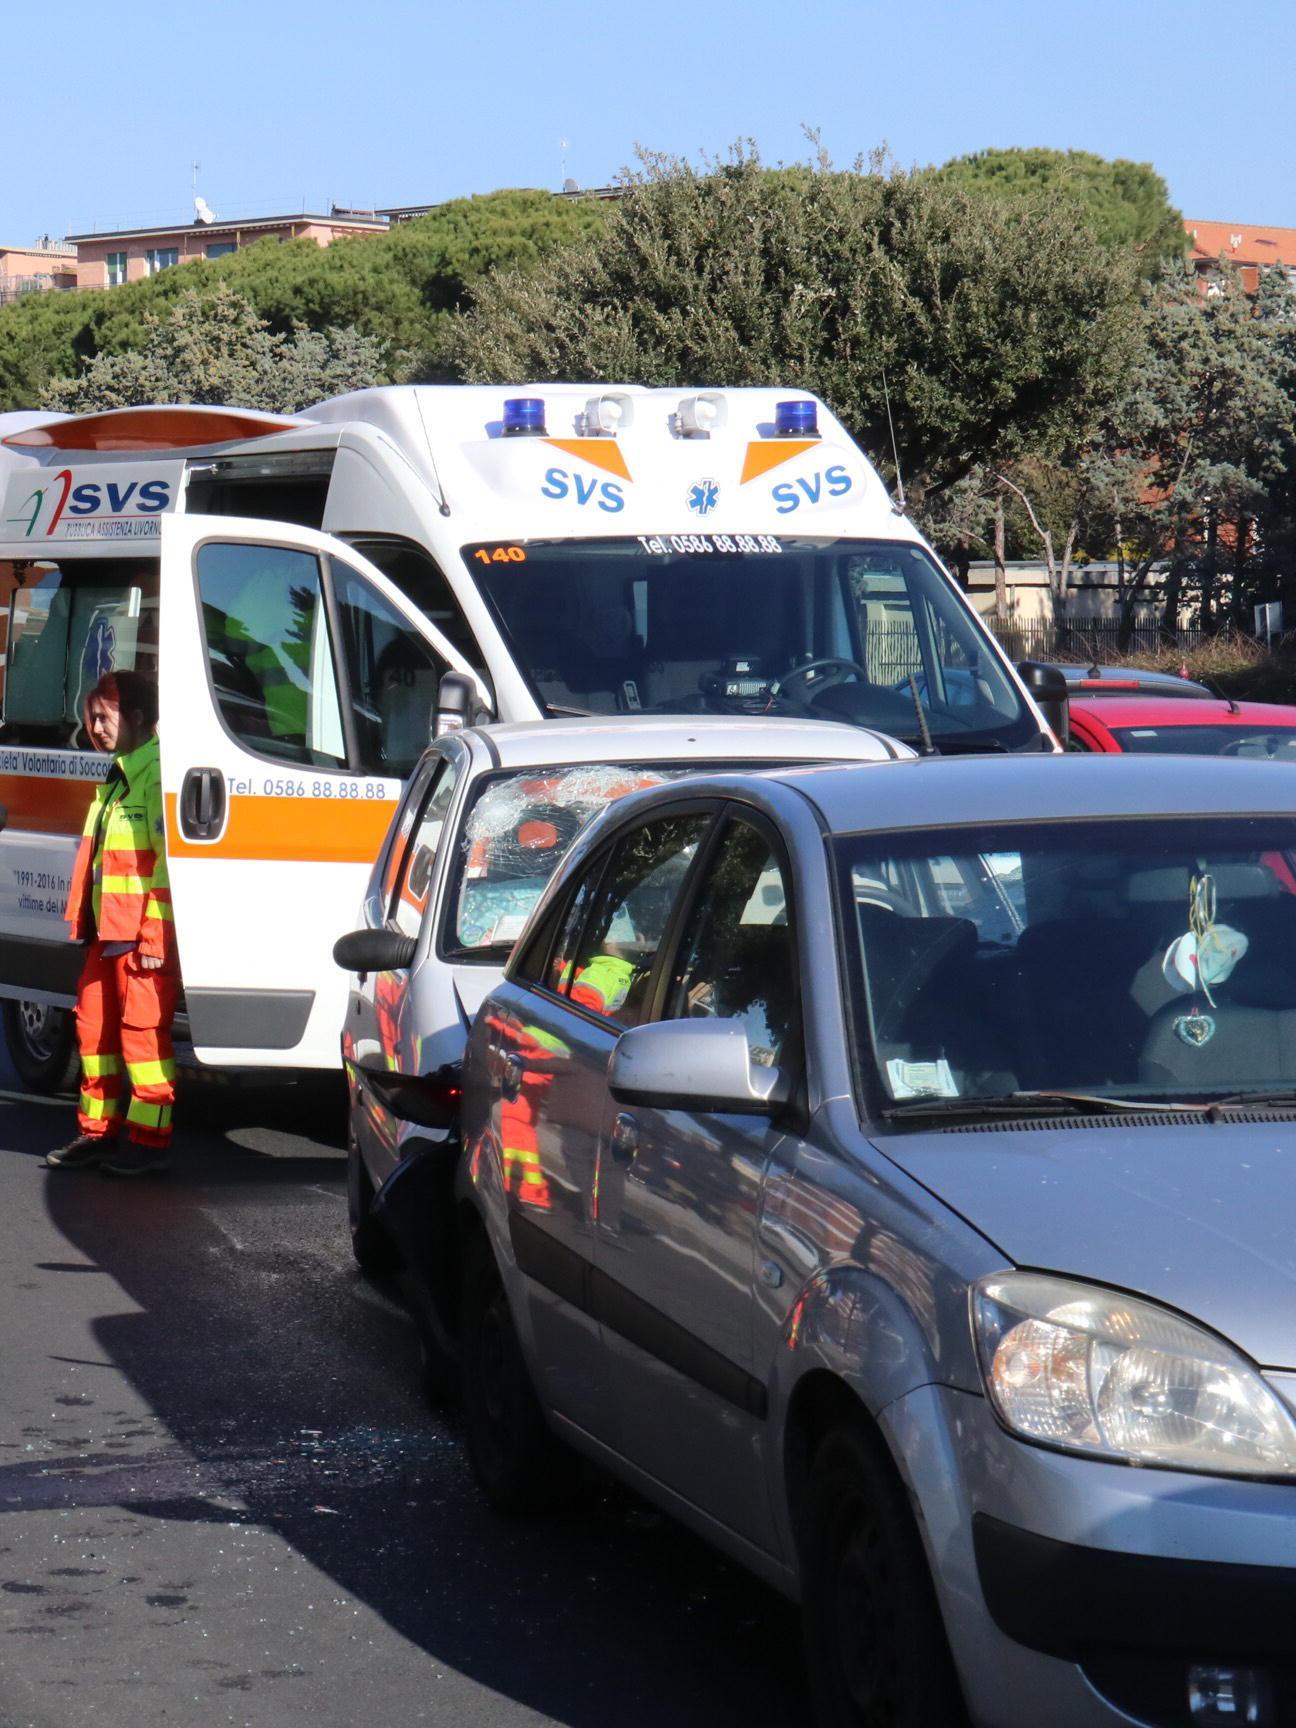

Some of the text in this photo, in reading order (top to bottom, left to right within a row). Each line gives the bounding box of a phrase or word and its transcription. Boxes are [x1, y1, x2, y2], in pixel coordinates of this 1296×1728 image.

[69, 480, 170, 514] SVS
[541, 467, 625, 513] SVS
[771, 465, 852, 514] SVS
[475, 546, 526, 564] 140
[637, 535, 782, 553] Tel. 0586 88.88.88
[22, 752, 66, 774] Volontaria
[69, 755, 77, 775] di
[227, 778, 386, 799] Tel. 0586 88.88.88
[46, 897, 59, 913] del
